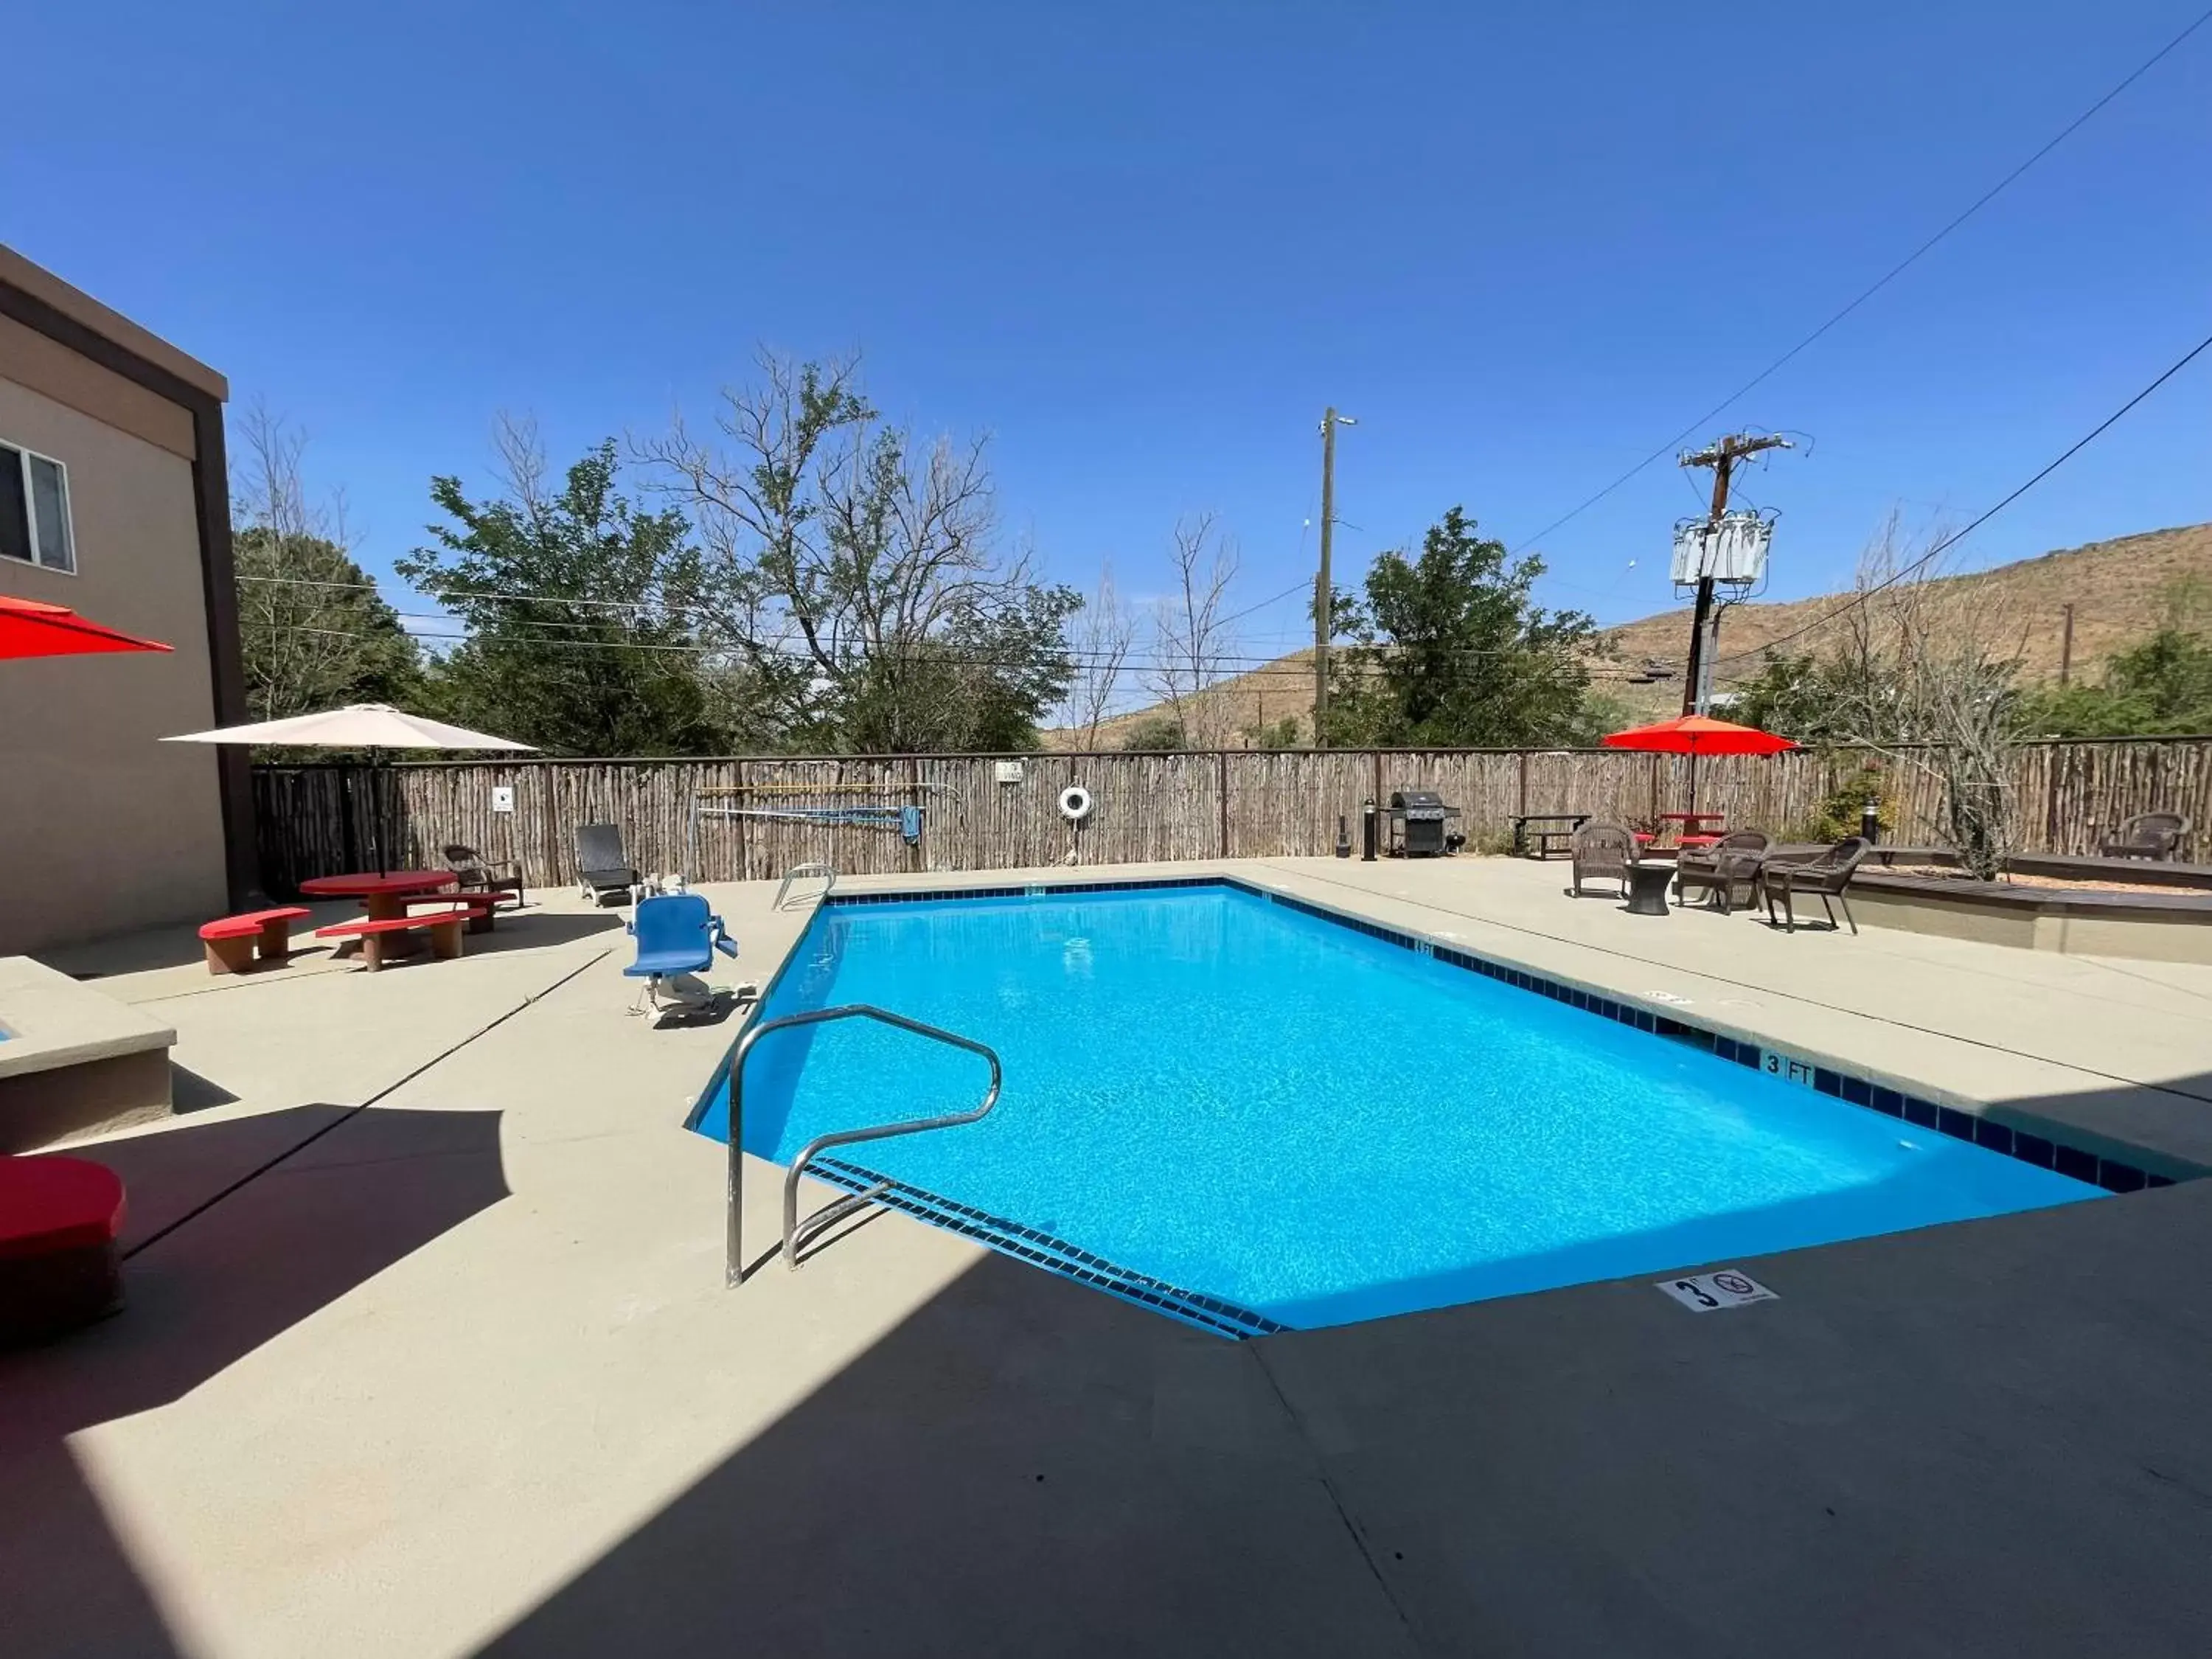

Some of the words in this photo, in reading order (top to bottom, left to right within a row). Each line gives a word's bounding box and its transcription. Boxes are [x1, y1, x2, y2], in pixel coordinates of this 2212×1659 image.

[1767, 1055, 1779, 1074] 3
[1789, 1061, 1811, 1085] FT
[1675, 1281, 1719, 1307] 3
